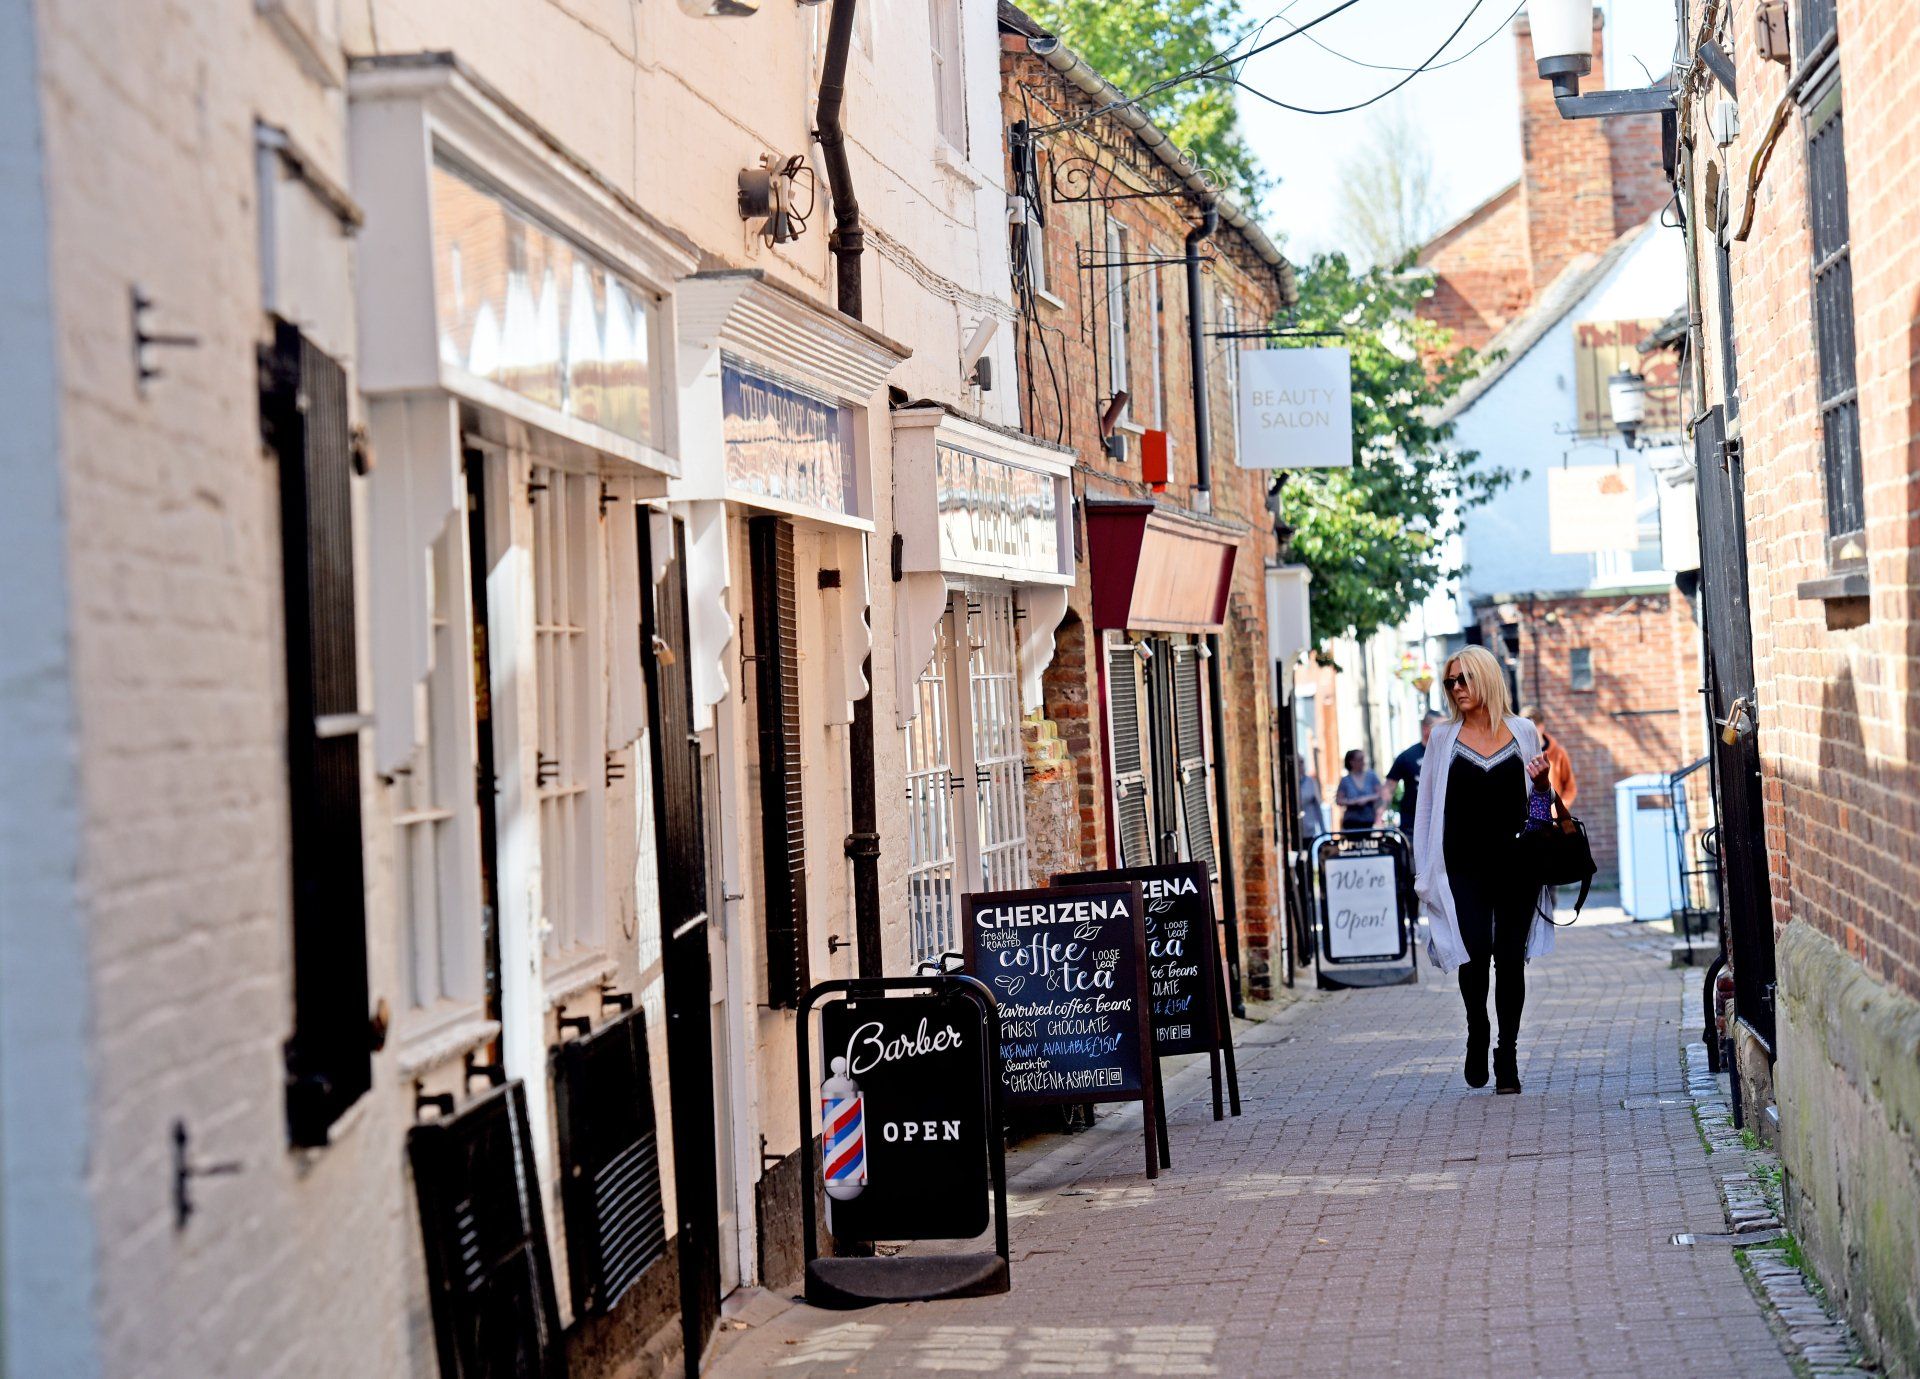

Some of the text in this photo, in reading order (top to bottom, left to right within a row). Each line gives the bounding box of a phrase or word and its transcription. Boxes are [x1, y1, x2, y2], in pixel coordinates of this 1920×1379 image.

[739, 380, 765, 423] THE
[1252, 388, 1336, 407] BEAUTY
[1261, 411, 1330, 428] SALON
[1331, 868, 1386, 890] We're
[976, 899, 1130, 929] CHERIZENA
[1164, 920, 1188, 930] LOOSE
[1335, 907, 1388, 939] Open!
[981, 928, 1018, 947] freshly
[986, 939, 1021, 951] ROASTED
[1147, 936, 1184, 957] ea
[1000, 932, 1087, 977] coffee
[1092, 949, 1121, 960] LOOSE
[1046, 961, 1115, 992] & tea
[1160, 961, 1198, 978] beans
[1054, 998, 1092, 1019] coffee
[1086, 994, 1132, 1013] beans
[1001, 1015, 1110, 1039] FINEST CHOCOLATE
[846, 1017, 962, 1080] Barber
[1000, 1042, 1039, 1059] AKEAWAY
[1042, 1037, 1093, 1056] AVAILABLE
[883, 1120, 961, 1142] OPEN
